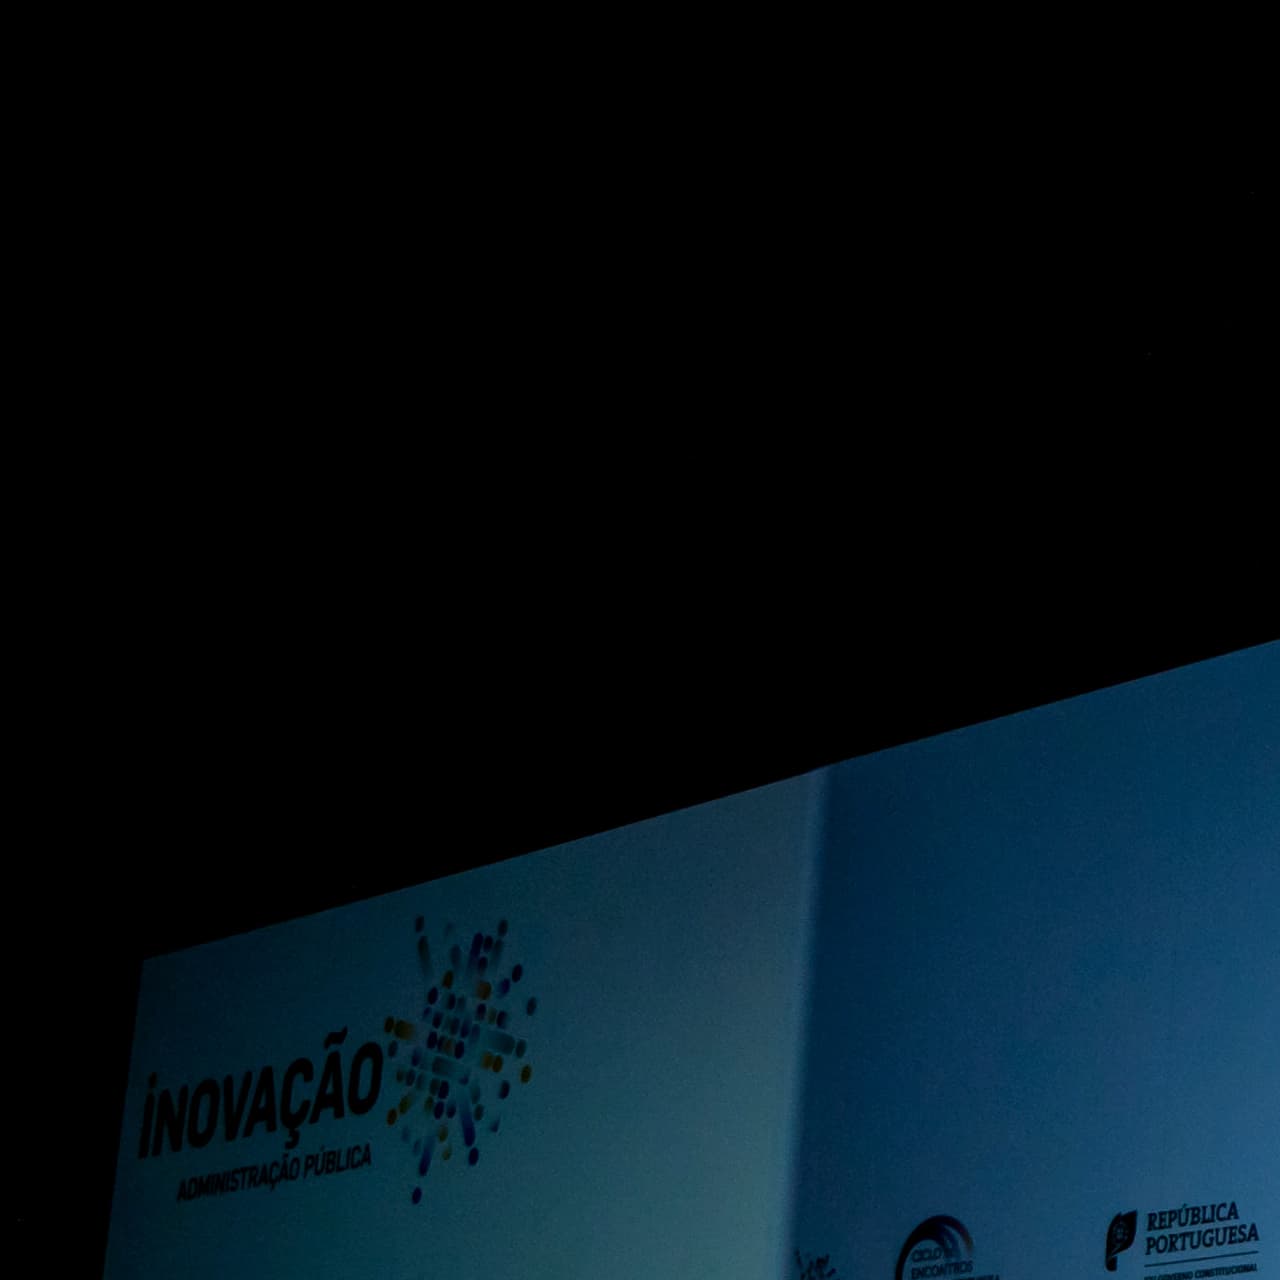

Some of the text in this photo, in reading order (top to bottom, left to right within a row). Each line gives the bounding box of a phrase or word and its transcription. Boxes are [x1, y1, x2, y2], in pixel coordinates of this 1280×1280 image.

[176, 1143, 372, 1203] ADMINISTRAÇÃO PÚBLICA
[1147, 1201, 1240, 1232] REPÚBLICA
[1145, 1222, 1260, 1256] PORTUGUESA
